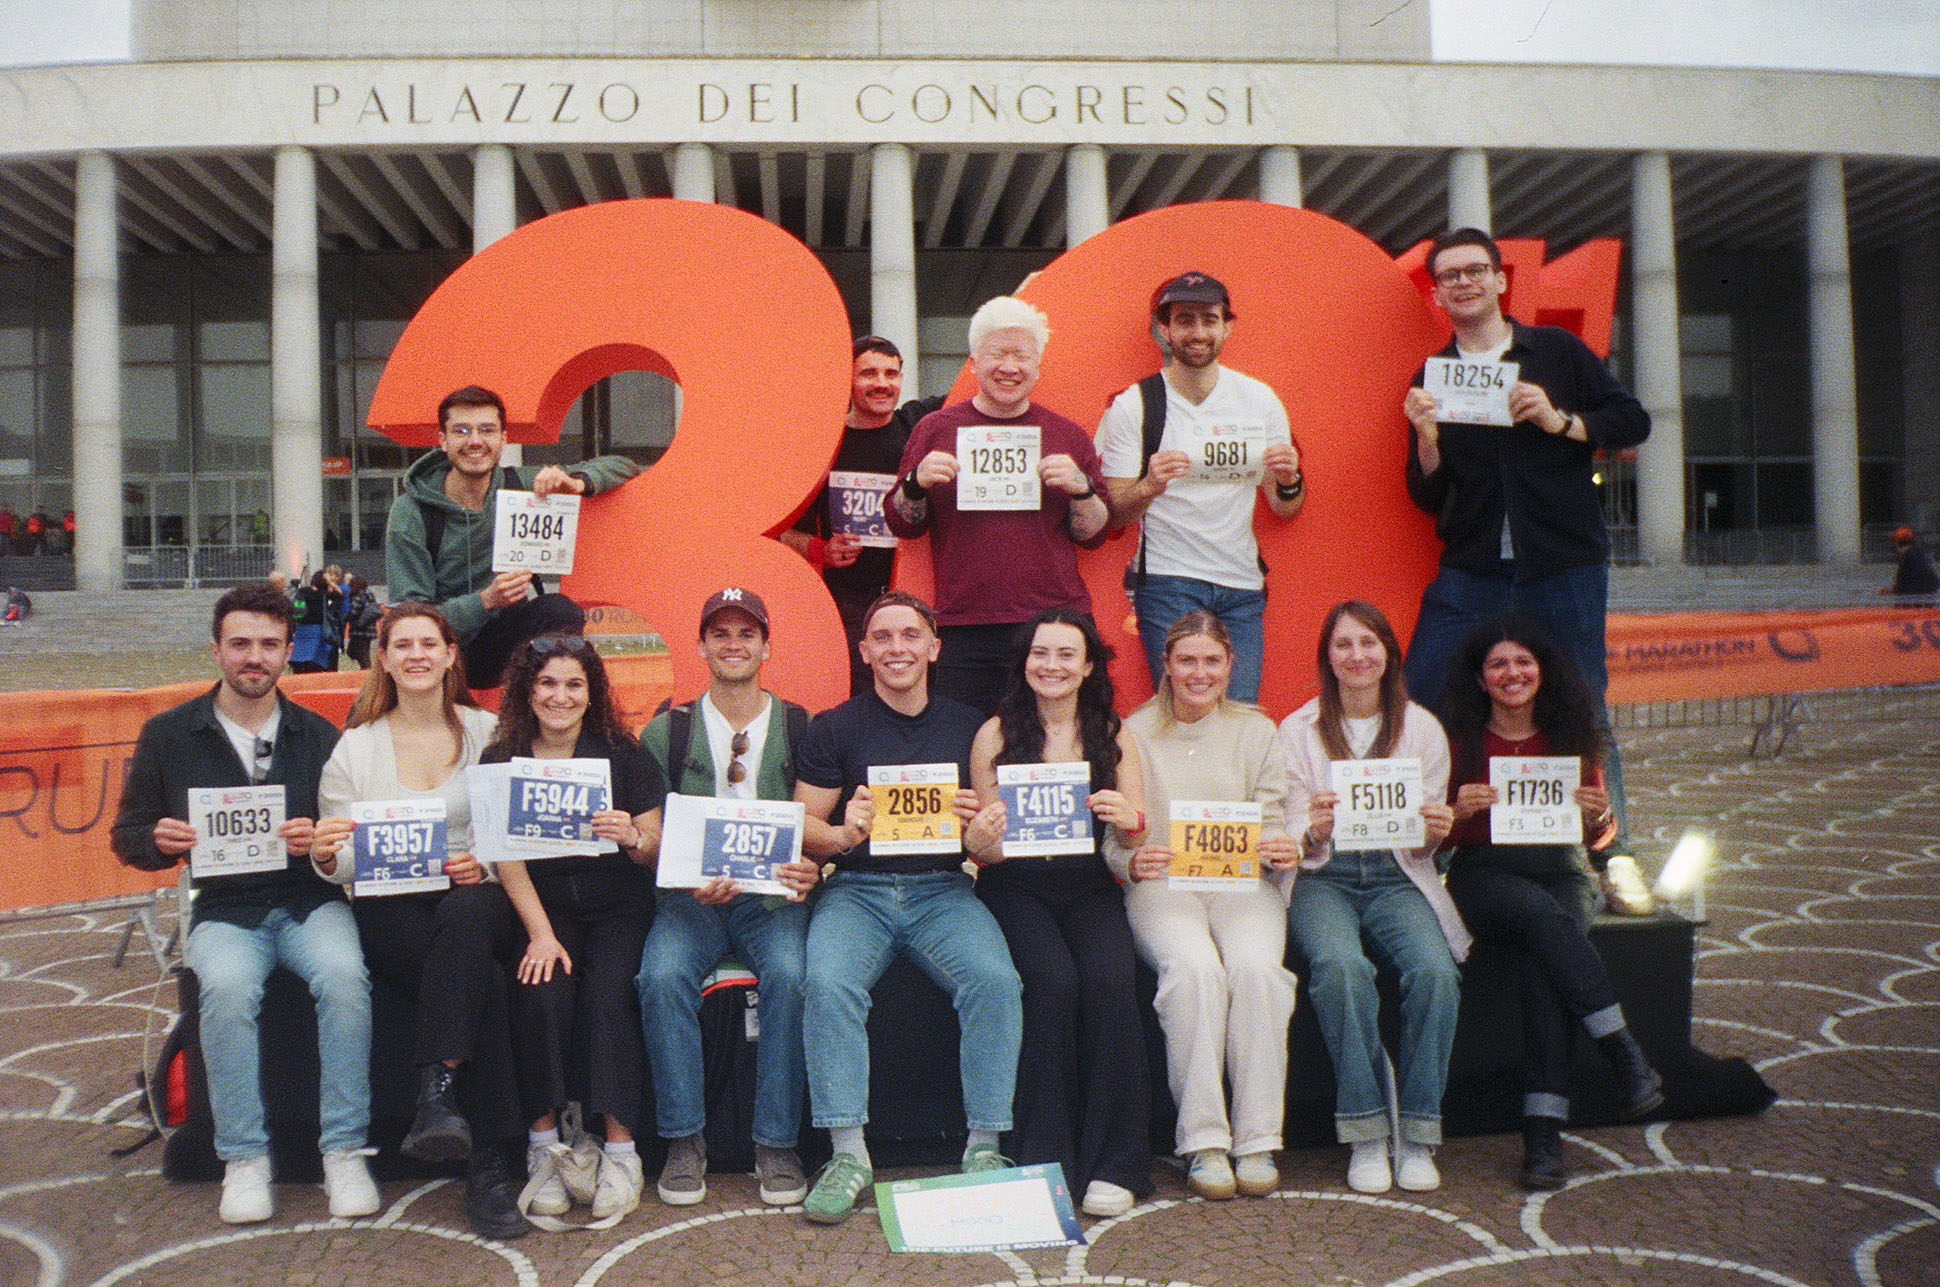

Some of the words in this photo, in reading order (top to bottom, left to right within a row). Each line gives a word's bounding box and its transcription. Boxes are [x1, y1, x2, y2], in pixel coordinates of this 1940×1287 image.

[312, 83, 640, 124] PALAZZO
[699, 83, 801, 124] DEI
[855, 83, 1254, 125] CONGRESSI
[1442, 363, 1504, 389] 18254
[970, 447, 1027, 474] 12853
[1204, 441, 1247, 467] 9681
[975, 486, 987, 498] 19
[1006, 484, 1017, 496] D
[510, 512, 564, 540] 13484
[868, 524, 880, 536] C
[510, 550, 524, 562] 20
[541, 550, 552, 561] D
[722, 587, 743, 600] NY
[1626, 640, 1755, 661] MARATHON
[522, 781, 589, 816] F5944
[888, 787, 941, 815] 2856
[1016, 784, 1076, 817] F4115
[1351, 782, 1406, 810] F5118
[1507, 779, 1563, 806] F1736
[205, 808, 271, 837] 10633
[525, 823, 542, 837] F9
[560, 825, 574, 839] C
[922, 825, 935, 838] A
[1019, 828, 1036, 841] F6
[1054, 824, 1068, 838] C
[1352, 824, 1368, 836] F8
[1387, 821, 1399, 833] D
[1542, 816, 1555, 828] D
[367, 822, 434, 857] F3957
[722, 823, 777, 856] 2857
[1184, 824, 1248, 853] F4863
[212, 849, 225, 861] 16
[247, 844, 260, 857] D
[374, 867, 391, 880] F6
[410, 863, 423, 877] C
[722, 865, 731, 878] 5
[754, 865, 767, 878] C
[1188, 865, 1203, 877] F7
[1221, 864, 1233, 876] A
[1014, 1239, 1080, 1250] MOVING
